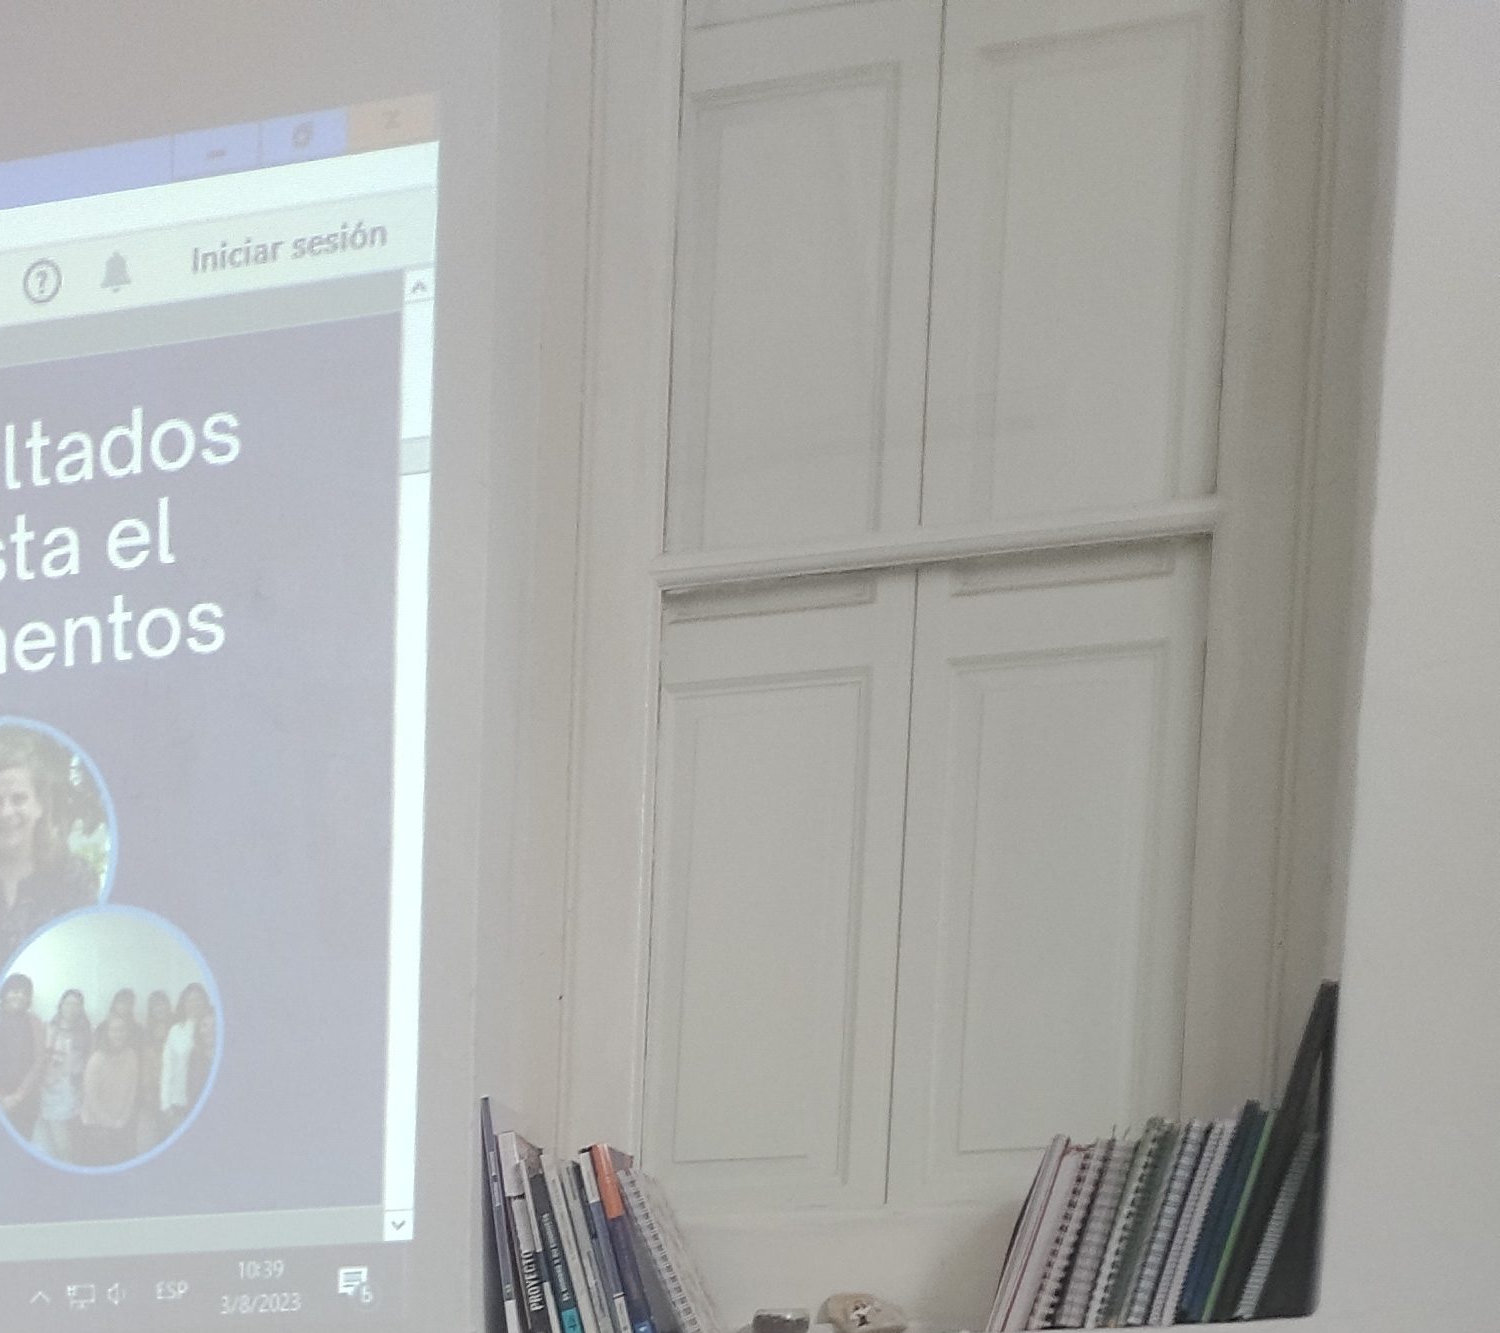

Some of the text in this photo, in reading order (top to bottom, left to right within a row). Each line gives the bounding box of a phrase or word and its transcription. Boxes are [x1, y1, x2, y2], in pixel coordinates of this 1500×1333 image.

[191, 221, 388, 274] Iniciar sesión
[106, 497, 175, 571] el
[238, 1259, 285, 1280] 10:39
[156, 1280, 189, 1301] ESP
[220, 1292, 301, 1315] 3/8/2023
